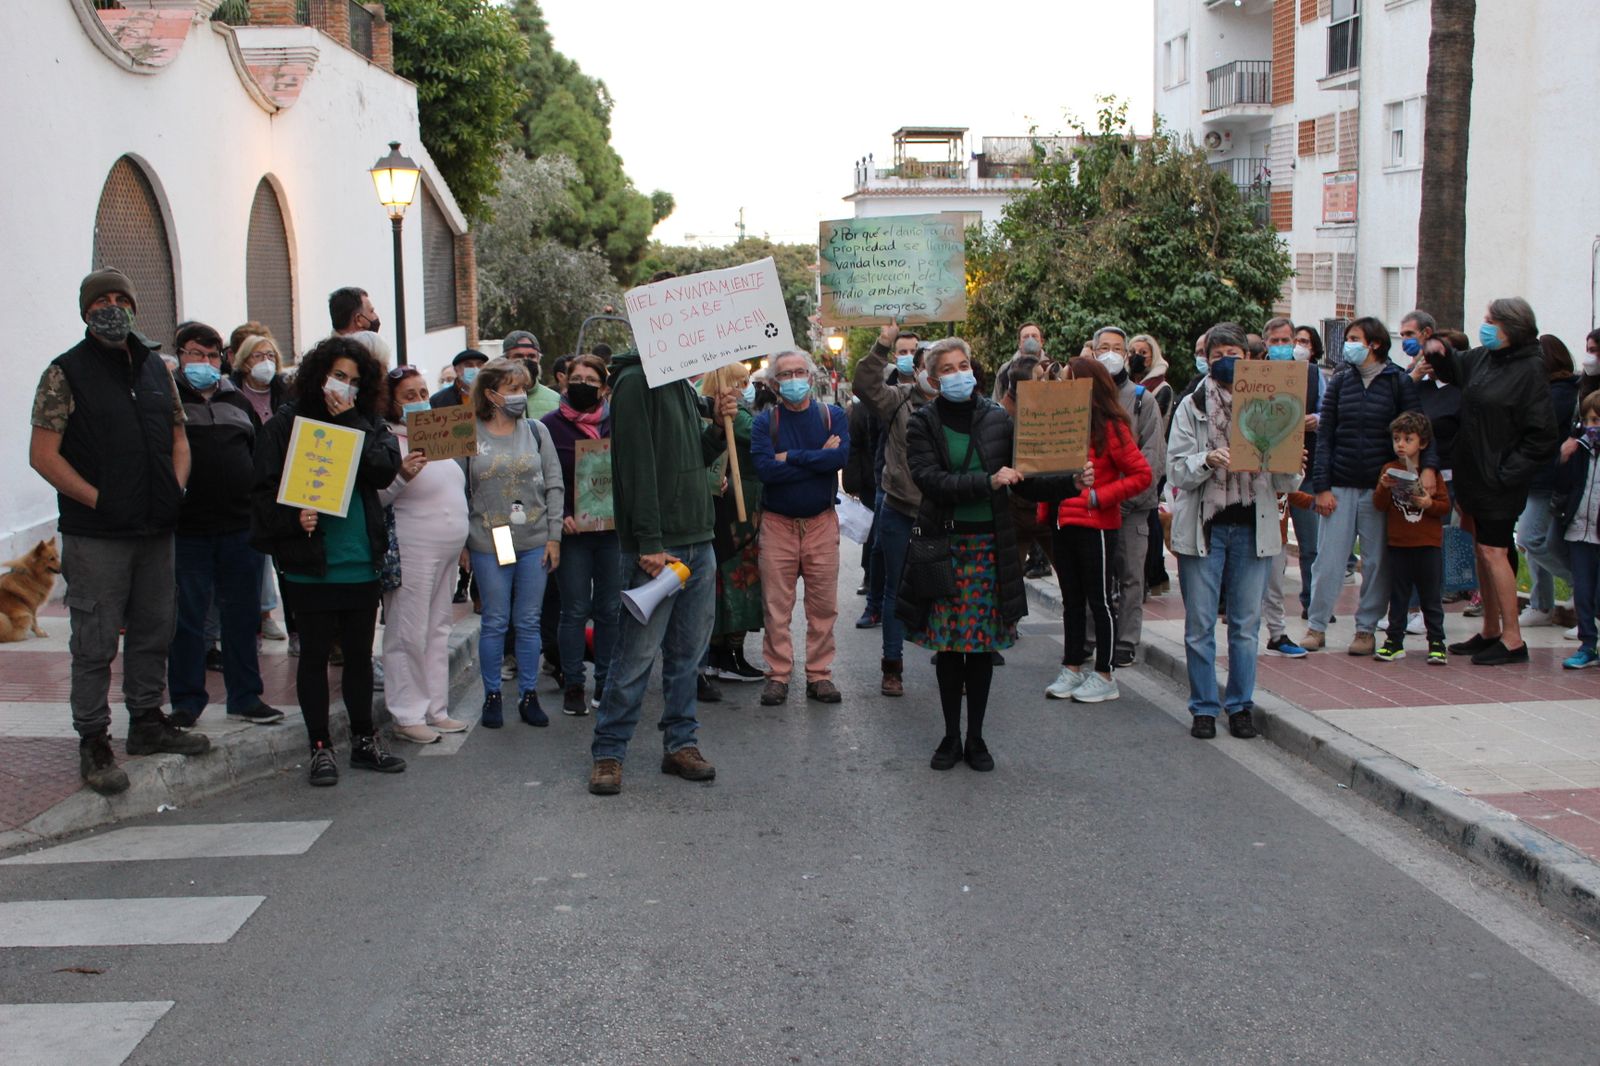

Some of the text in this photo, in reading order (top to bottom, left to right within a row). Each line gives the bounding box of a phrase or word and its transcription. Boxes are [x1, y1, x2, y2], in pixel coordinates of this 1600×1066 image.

[830, 223, 955, 244] ¿Por qué el daño a la
[832, 238, 960, 258] propiedad se llama
[846, 270, 911, 285] destrucción
[918, 268, 942, 282] del
[664, 271, 766, 303] AYUNTAMIENTE
[832, 281, 953, 300] medio ambiente se
[649, 299, 722, 333] NO SABE
[648, 308, 768, 358] LO QUE HACE!!!
[680, 358, 699, 369] como
[1234, 379, 1276, 393] Quiero
[1243, 397, 1287, 415] VIVIR
[414, 412, 448, 428] Estoy
[413, 430, 449, 442] Quiero
